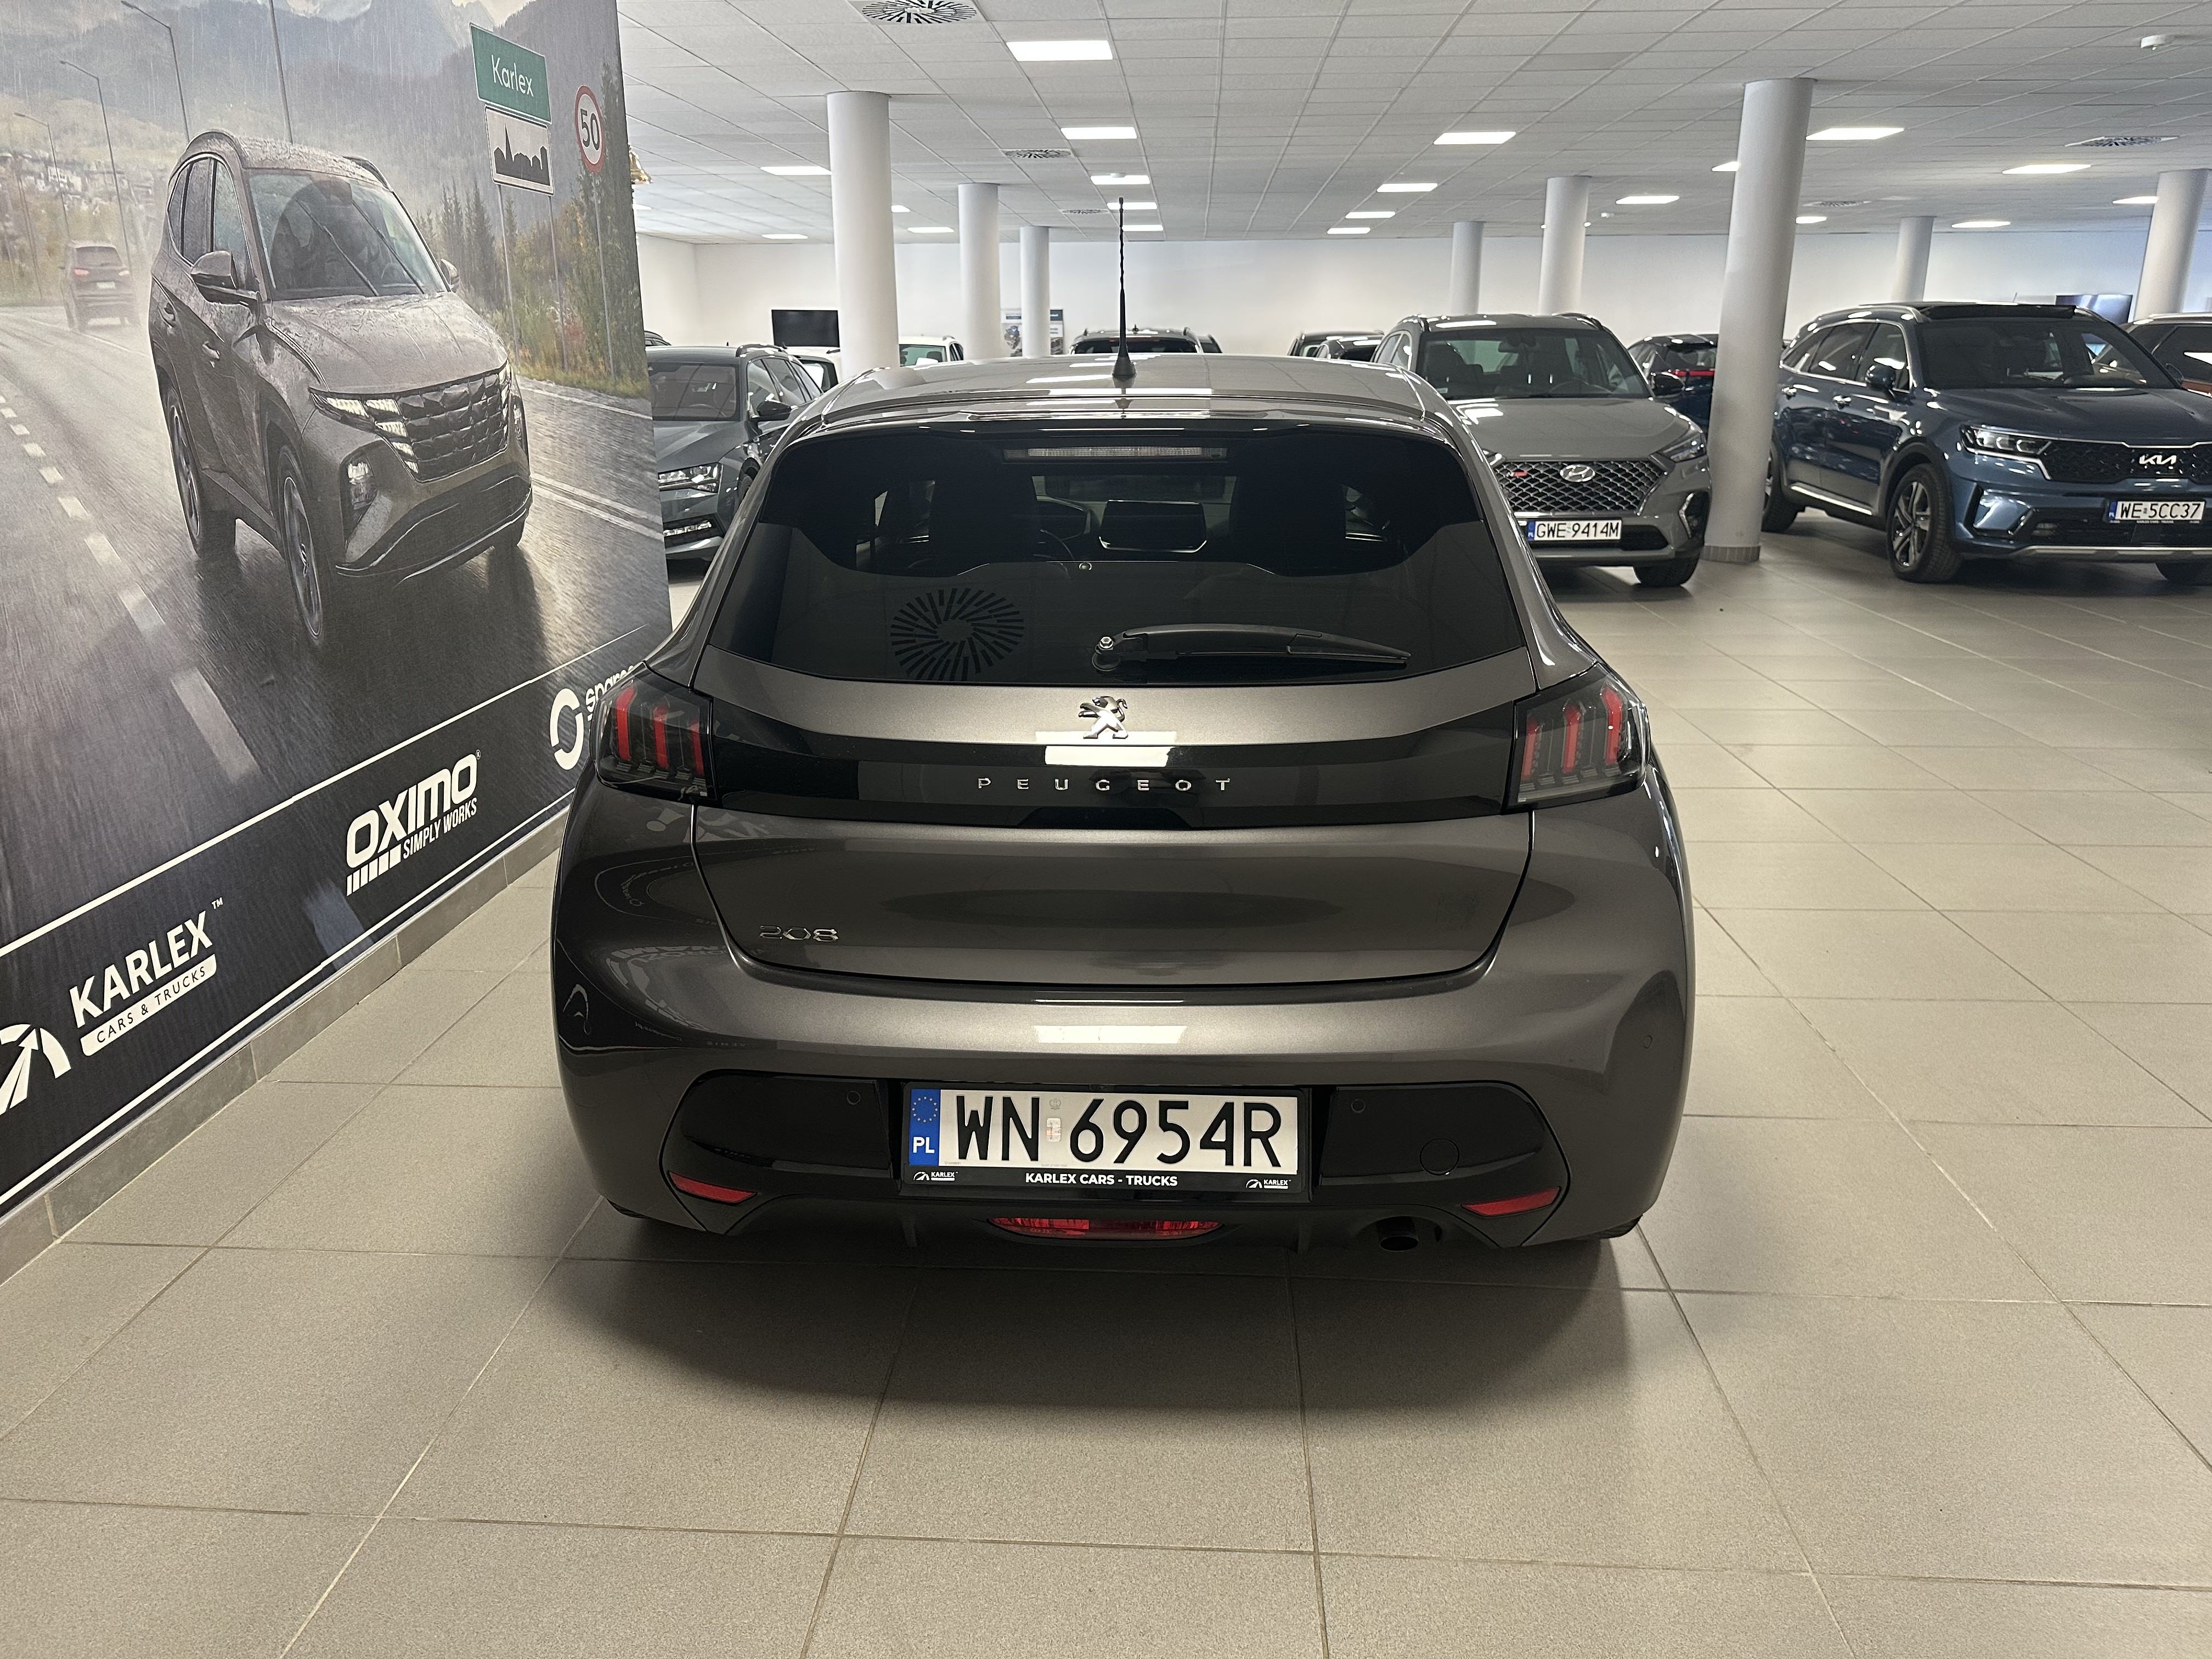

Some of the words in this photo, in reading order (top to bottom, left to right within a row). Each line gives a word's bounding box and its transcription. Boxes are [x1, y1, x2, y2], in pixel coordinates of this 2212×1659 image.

[491, 55, 534, 97] Karlex
[580, 108, 600, 151] 50
[1536, 523, 1567, 538] GWE
[1572, 522, 1618, 538] 9414M
[2120, 503, 2143, 518] WE
[2148, 503, 2201, 518] 5CC37
[978, 777, 1231, 791] PEUGEOT
[346, 754, 477, 868] OXIMO
[403, 819, 441, 859] SIMPLY
[443, 797, 477, 834] WORKS
[760, 925, 839, 942] 208
[69, 910, 213, 1028] KARLEX
[97, 1012, 133, 1043] CARS
[141, 1004, 149, 1015] &
[154, 966, 205, 1006] TRUCKS
[912, 1137, 935, 1154] PL
[956, 1095, 1040, 1161] WN
[1070, 1098, 1282, 1167] 6954R
[1025, 1172, 1077, 1184] KARLEX
[1079, 1174, 1115, 1185] CARS
[1126, 1175, 1178, 1186] TRUCKS
